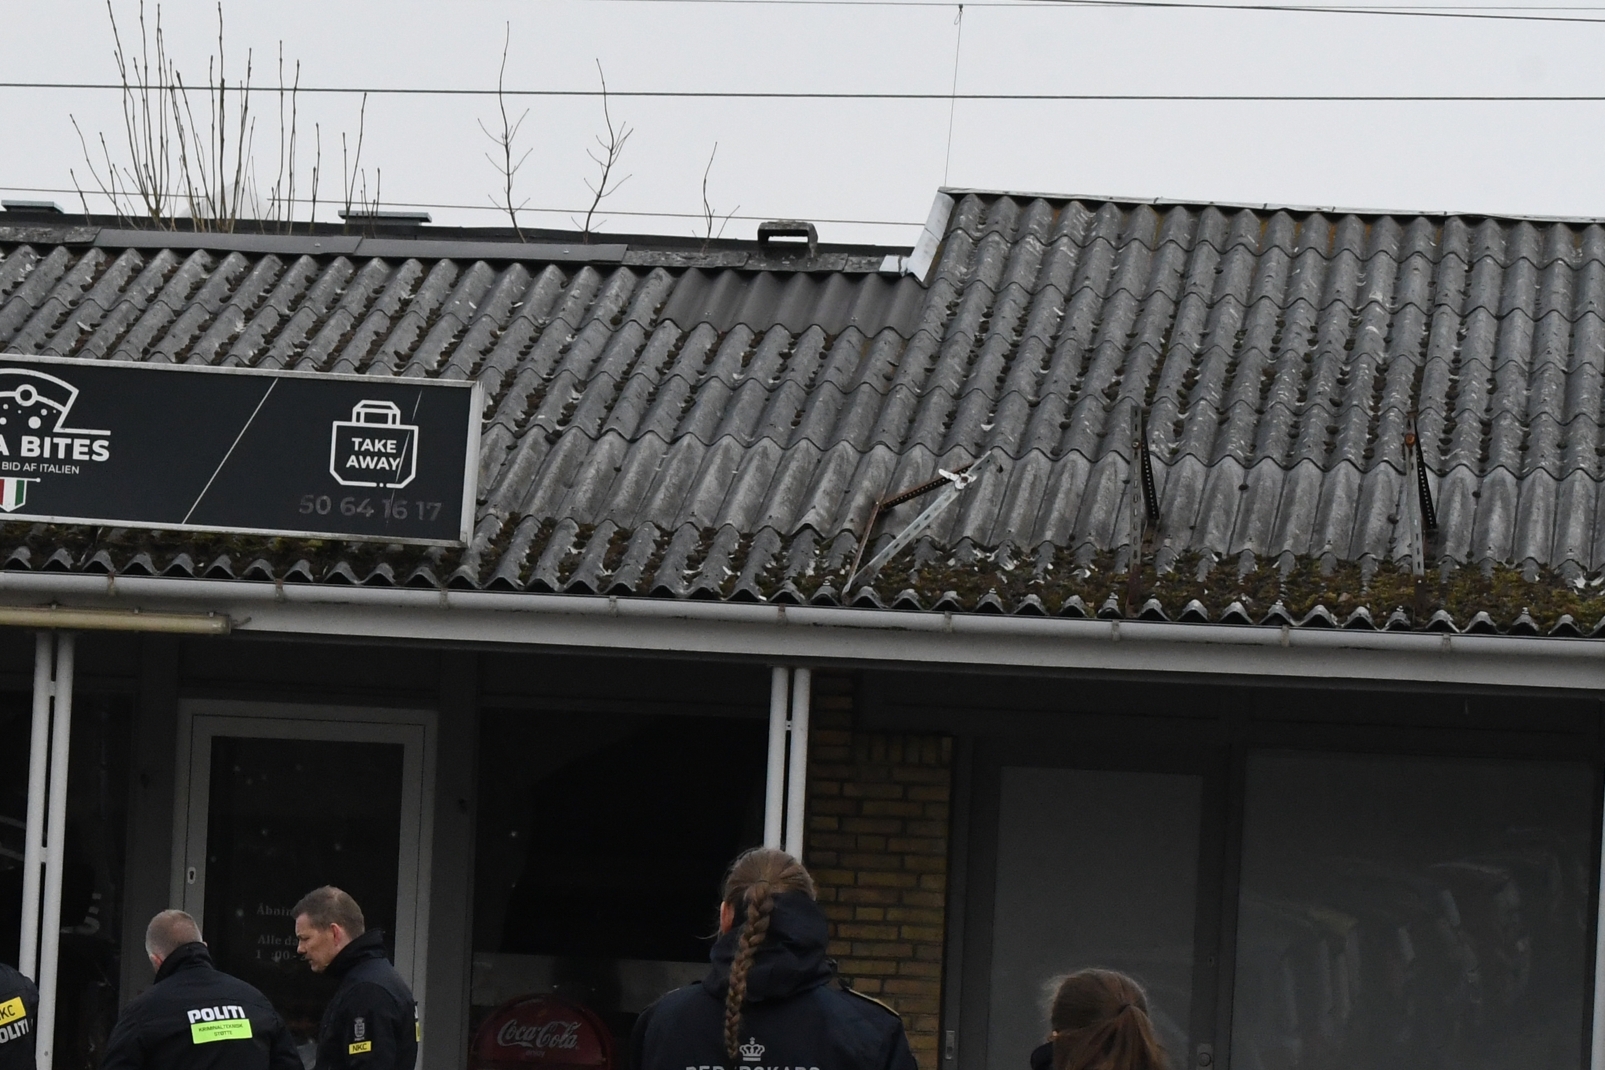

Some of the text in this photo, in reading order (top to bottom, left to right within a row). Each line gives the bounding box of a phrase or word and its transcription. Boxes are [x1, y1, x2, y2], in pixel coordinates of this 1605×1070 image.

[20, 435, 110, 462] BITES
[351, 437, 397, 453] TAKE
[1, 461, 21, 472] BID
[22, 463, 38, 473] AF
[39, 463, 80, 475] ITALIEN
[346, 455, 400, 471] AWAY
[299, 494, 442, 521] 50 64 16 17
[257, 934, 282, 945] Alle
[187, 1005, 246, 1024] POLITI
[198, 1023, 244, 1032] KRIMINALTEKNISK
[497, 1019, 583, 1049] Coca-Cola
[352, 1043, 368, 1052] NKC
